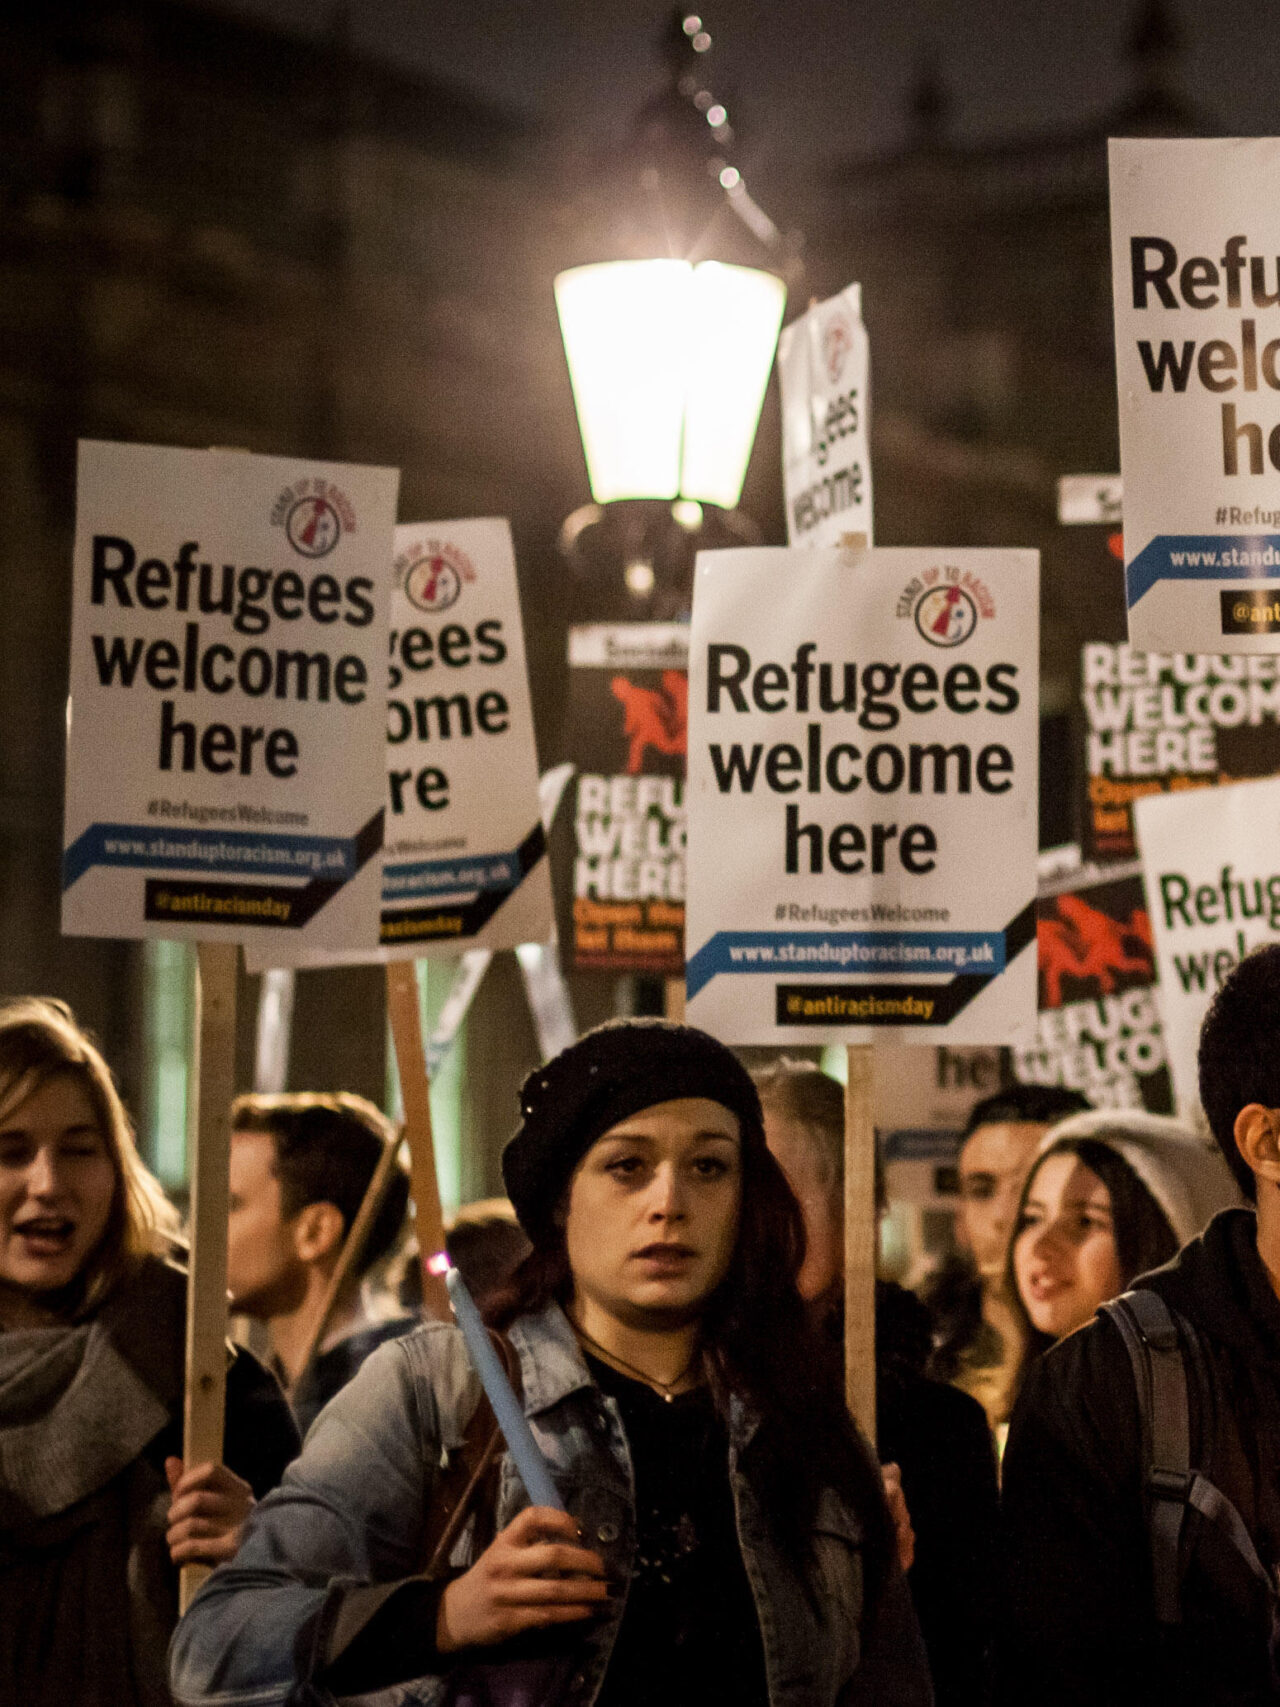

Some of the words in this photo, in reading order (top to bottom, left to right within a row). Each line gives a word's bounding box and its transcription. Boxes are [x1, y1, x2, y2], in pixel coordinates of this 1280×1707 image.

[90, 535, 375, 635] Refugees
[92, 622, 367, 702] welcome
[706, 643, 1020, 731] Refugees
[158, 701, 298, 777] here
[709, 724, 1014, 794] welcome
[1088, 728, 1217, 775] HERE
[148, 800, 308, 827] #RefugeesWelcome
[389, 766, 449, 814] re
[105, 836, 345, 870] www.standuptoracism.org.uk
[785, 805, 937, 874] here
[155, 893, 290, 920] @antiracismday
[775, 904, 950, 927] #RefugeesWelcome
[730, 942, 994, 966] www.standuptoracism.org.uk
[787, 997, 934, 1018] @antiracismday
